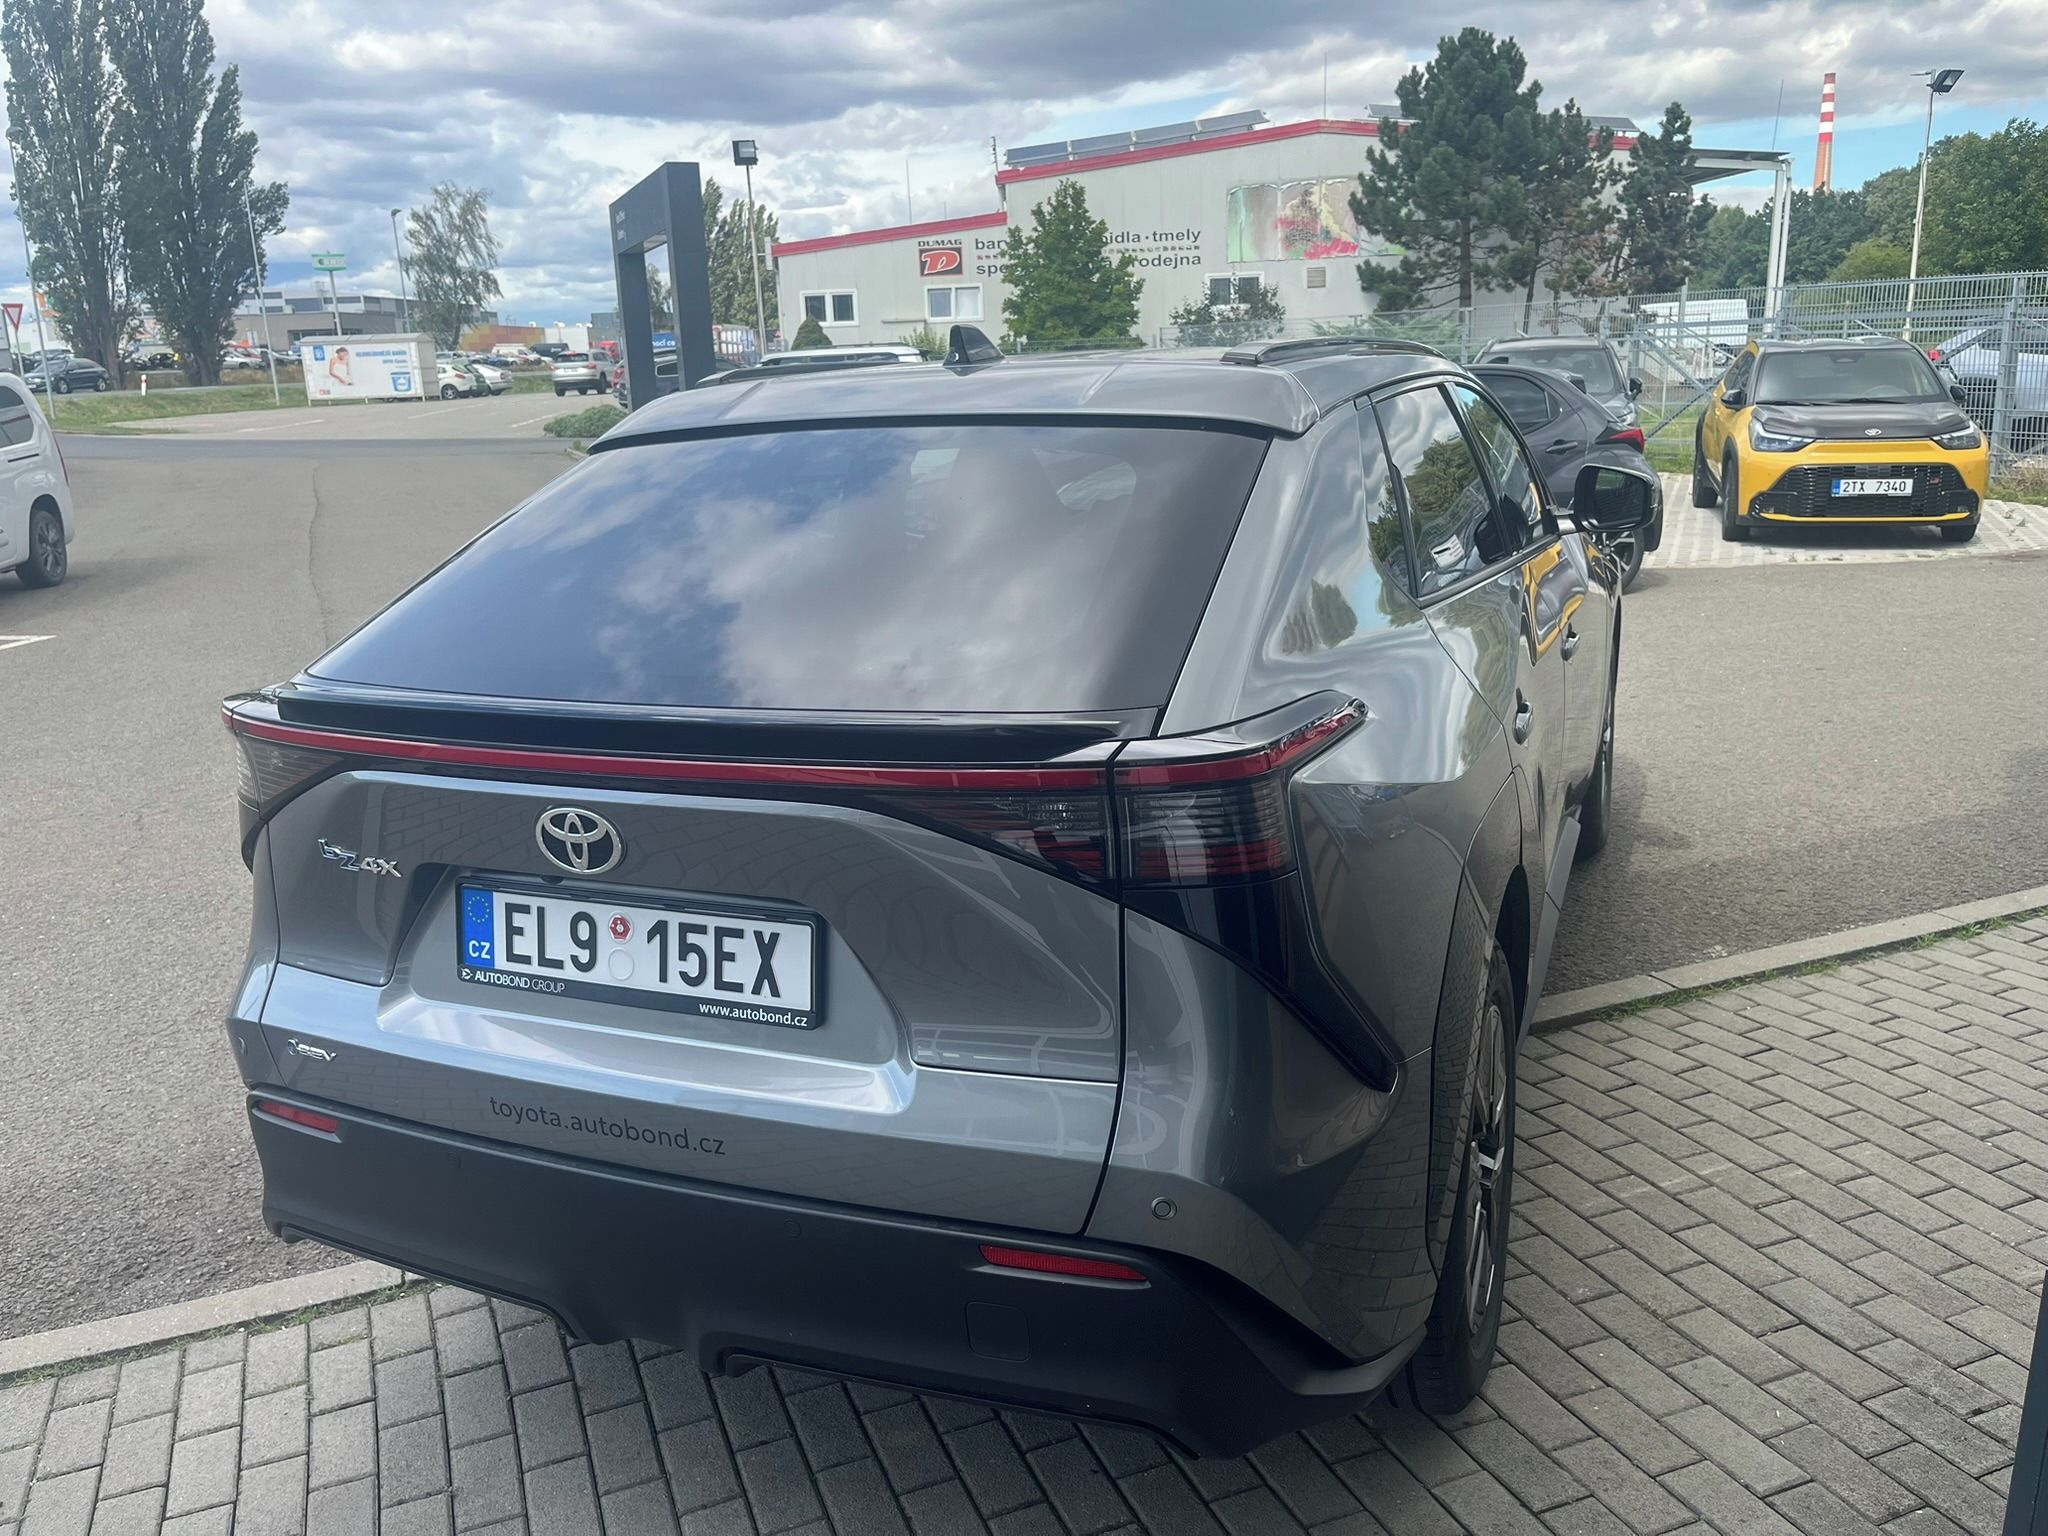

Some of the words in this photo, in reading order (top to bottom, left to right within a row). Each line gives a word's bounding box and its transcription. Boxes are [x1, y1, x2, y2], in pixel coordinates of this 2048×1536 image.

[918, 239, 962, 247] DUMAG
[1152, 228, 1201, 243] tmely
[1843, 481, 1866, 492] 2TX
[1876, 480, 1907, 492] 7340
[468, 940, 491, 960] CZ
[504, 902, 598, 973] EL9
[646, 919, 781, 998] 15EX
[474, 969, 530, 989] AUTOBOND
[531, 978, 566, 993] GROUP
[699, 1003, 808, 1028] www.autobond.cz
[489, 1096, 727, 1156] toyota.autobond.cz
